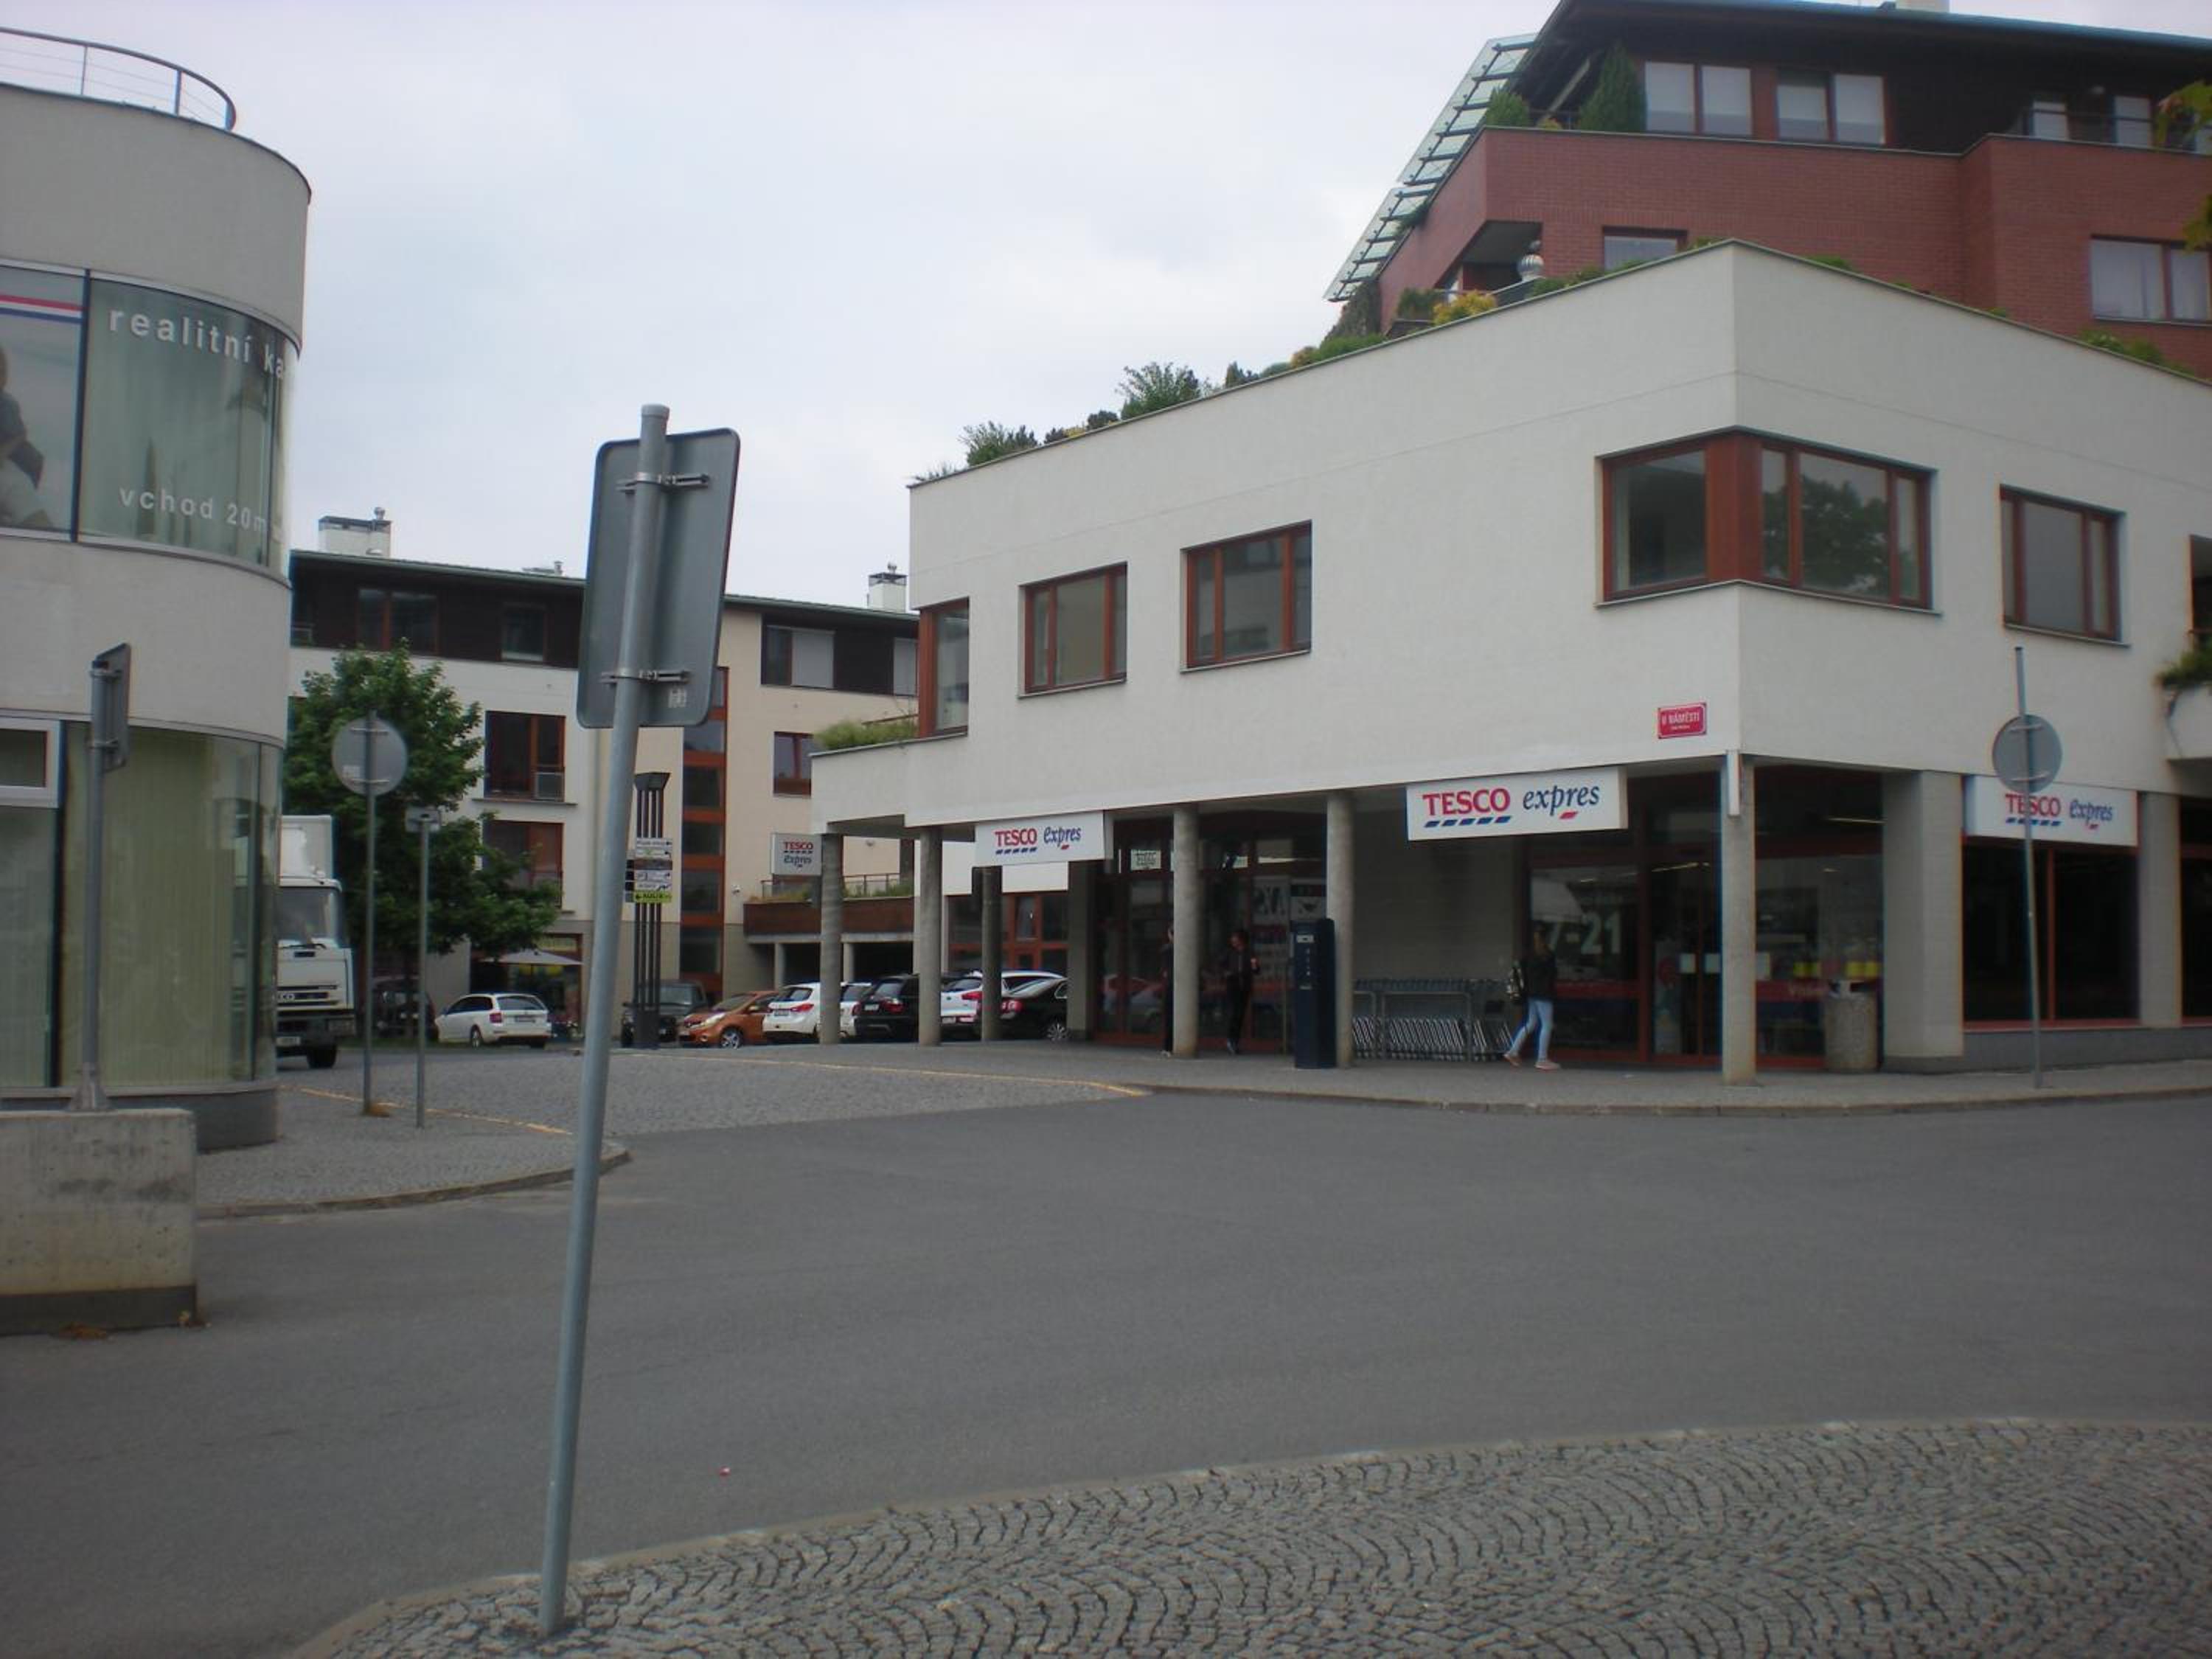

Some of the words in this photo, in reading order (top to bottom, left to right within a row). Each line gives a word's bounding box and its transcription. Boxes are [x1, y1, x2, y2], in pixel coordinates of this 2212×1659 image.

[110, 308, 251, 364] realitní
[119, 487, 214, 518] vchod
[1423, 788, 1511, 815] TESCO
[1523, 785, 1600, 816] expres
[2005, 793, 2062, 817] TESCO
[2070, 799, 2113, 824] expres
[783, 841, 813, 850] TESCO
[995, 828, 1037, 846] TESCO
[1043, 826, 1082, 847] expres
